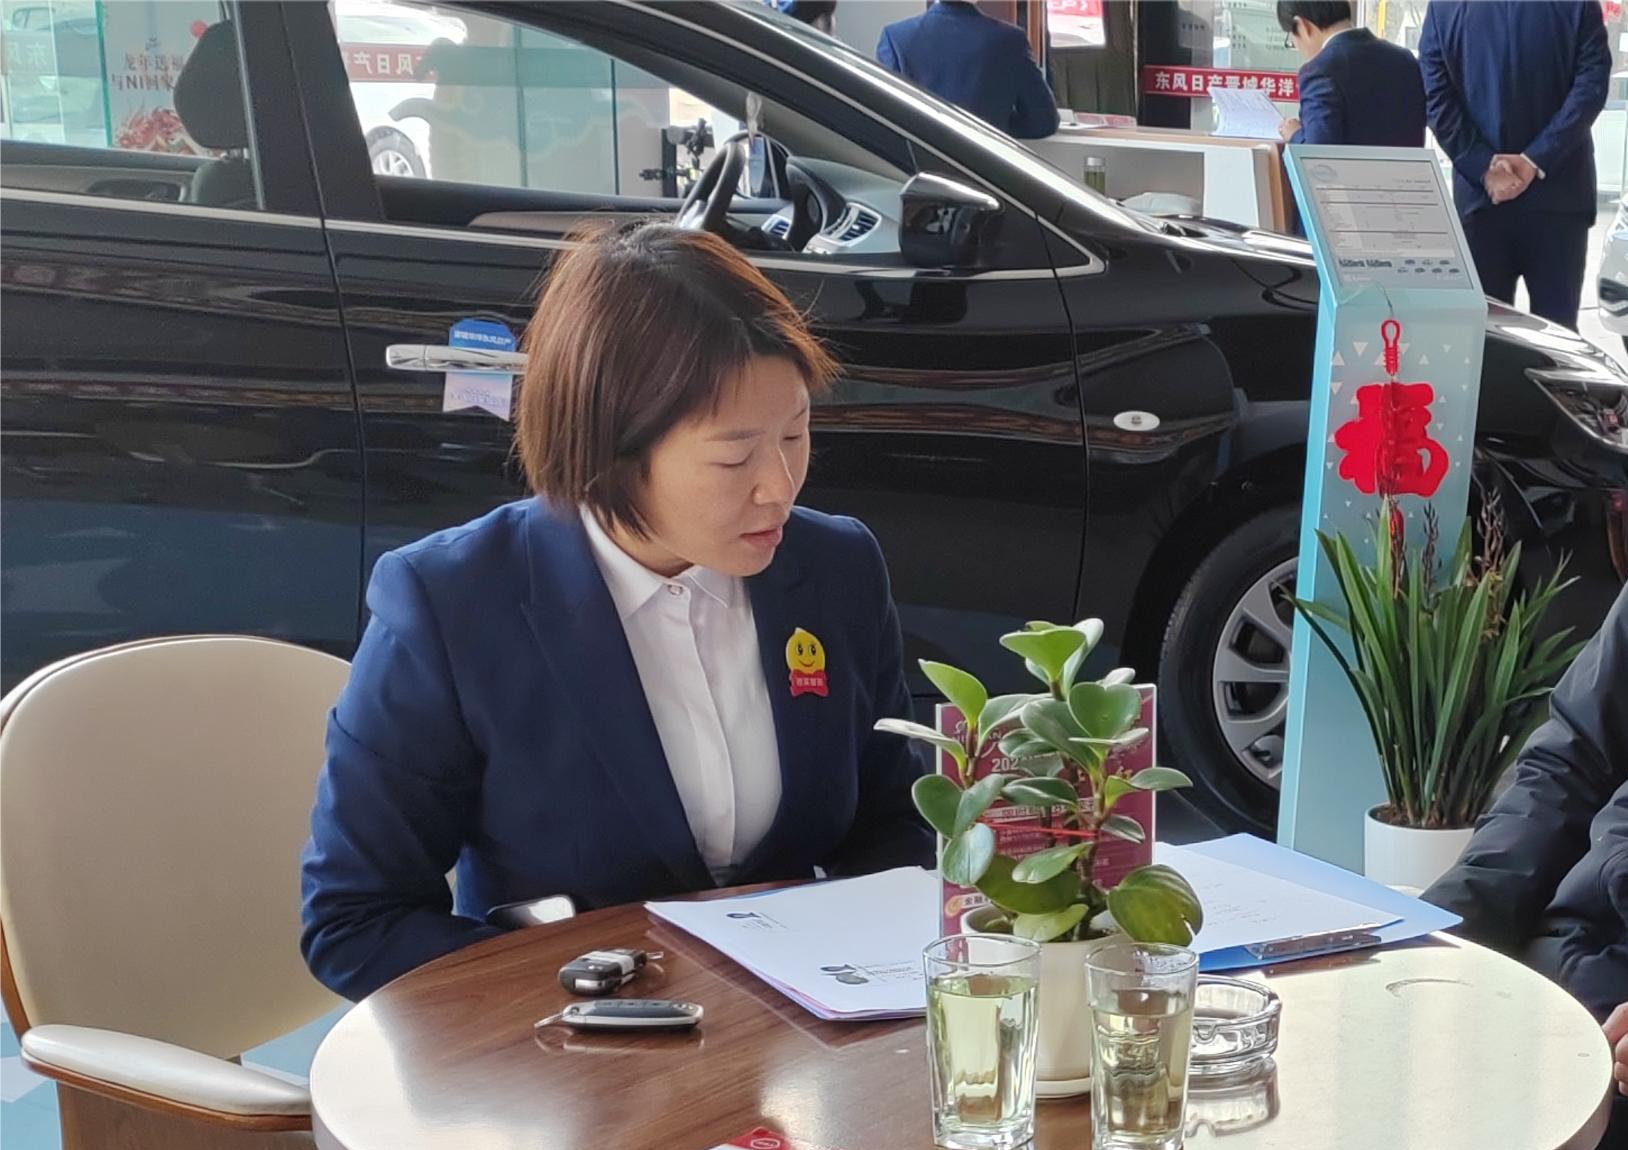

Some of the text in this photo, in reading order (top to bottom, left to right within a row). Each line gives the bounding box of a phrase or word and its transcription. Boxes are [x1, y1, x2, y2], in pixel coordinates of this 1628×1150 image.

[1155, 70, 1300, 97] 东风日产晋城华洋
